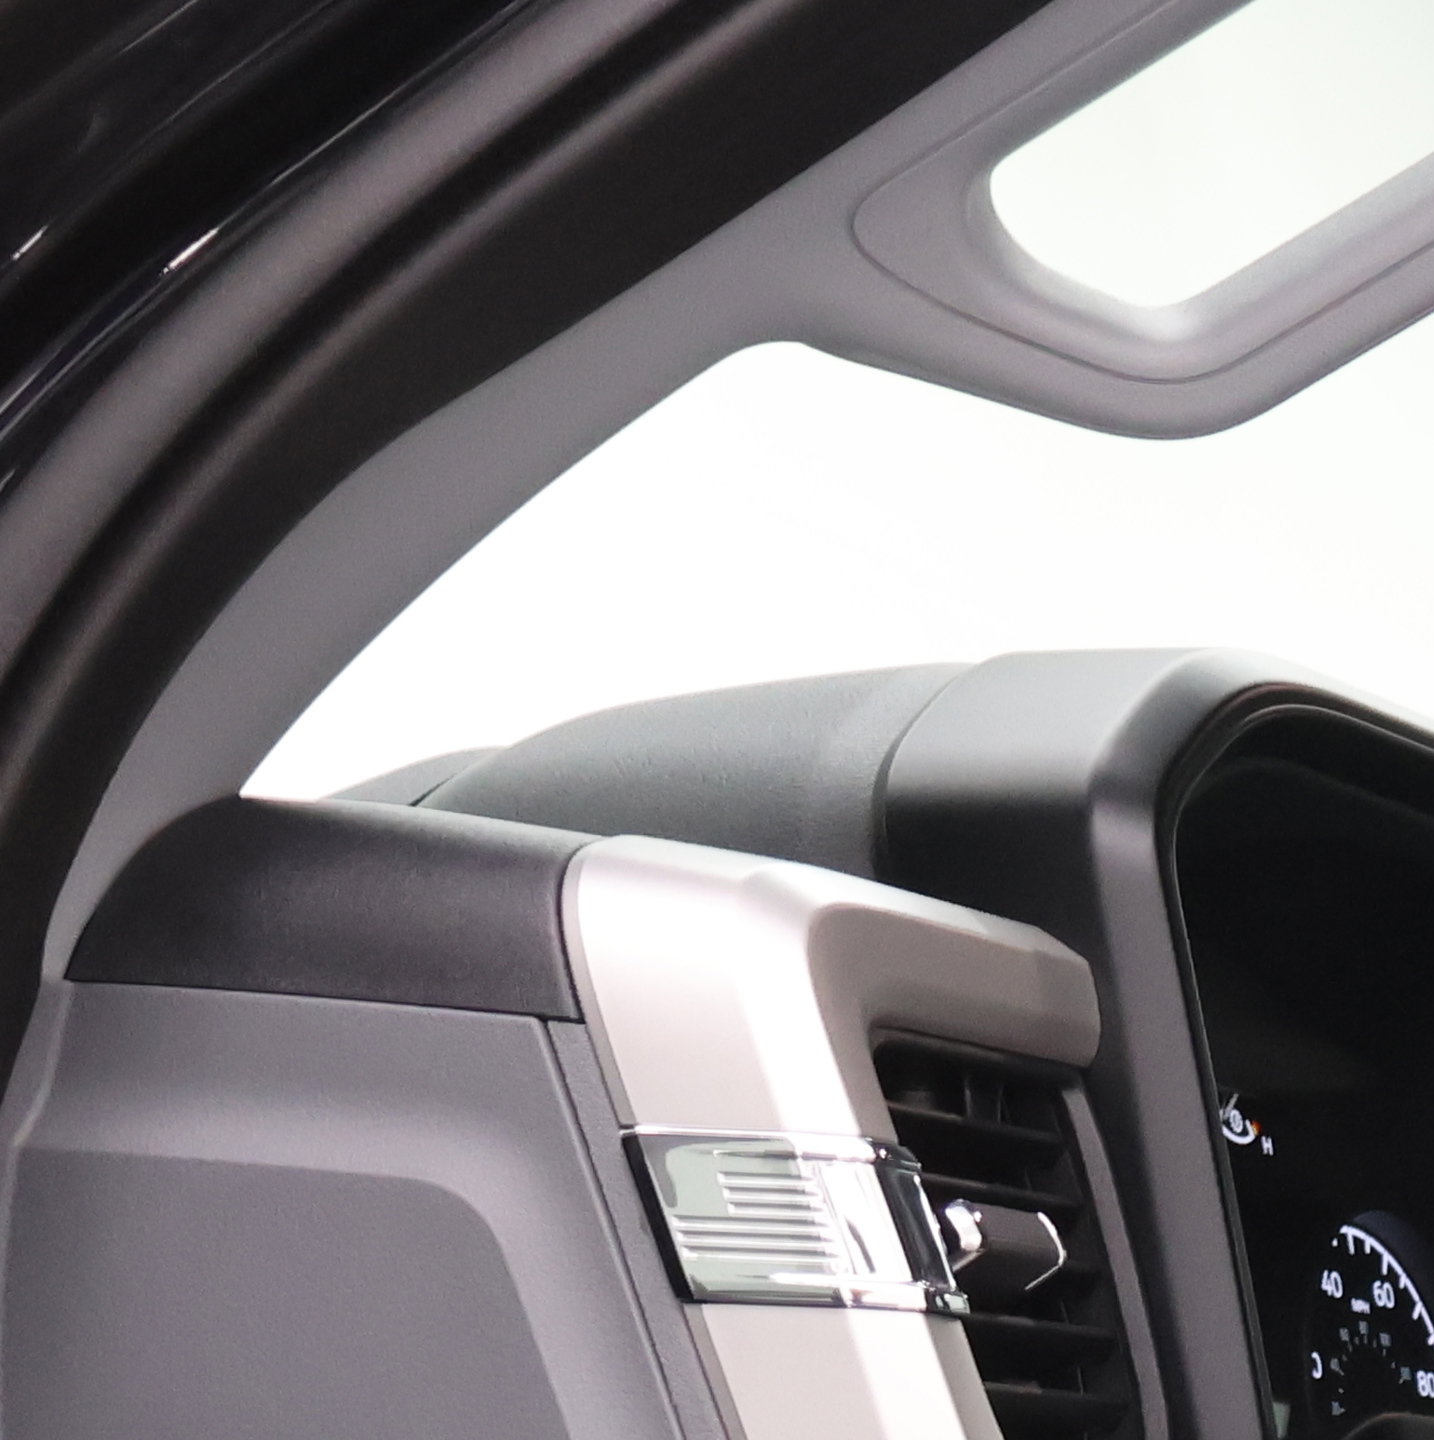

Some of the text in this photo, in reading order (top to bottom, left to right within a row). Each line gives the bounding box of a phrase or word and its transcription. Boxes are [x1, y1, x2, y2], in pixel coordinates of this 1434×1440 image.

[1260, 1136, 1275, 1156] H
[1321, 1269, 1395, 1309] 40 60
